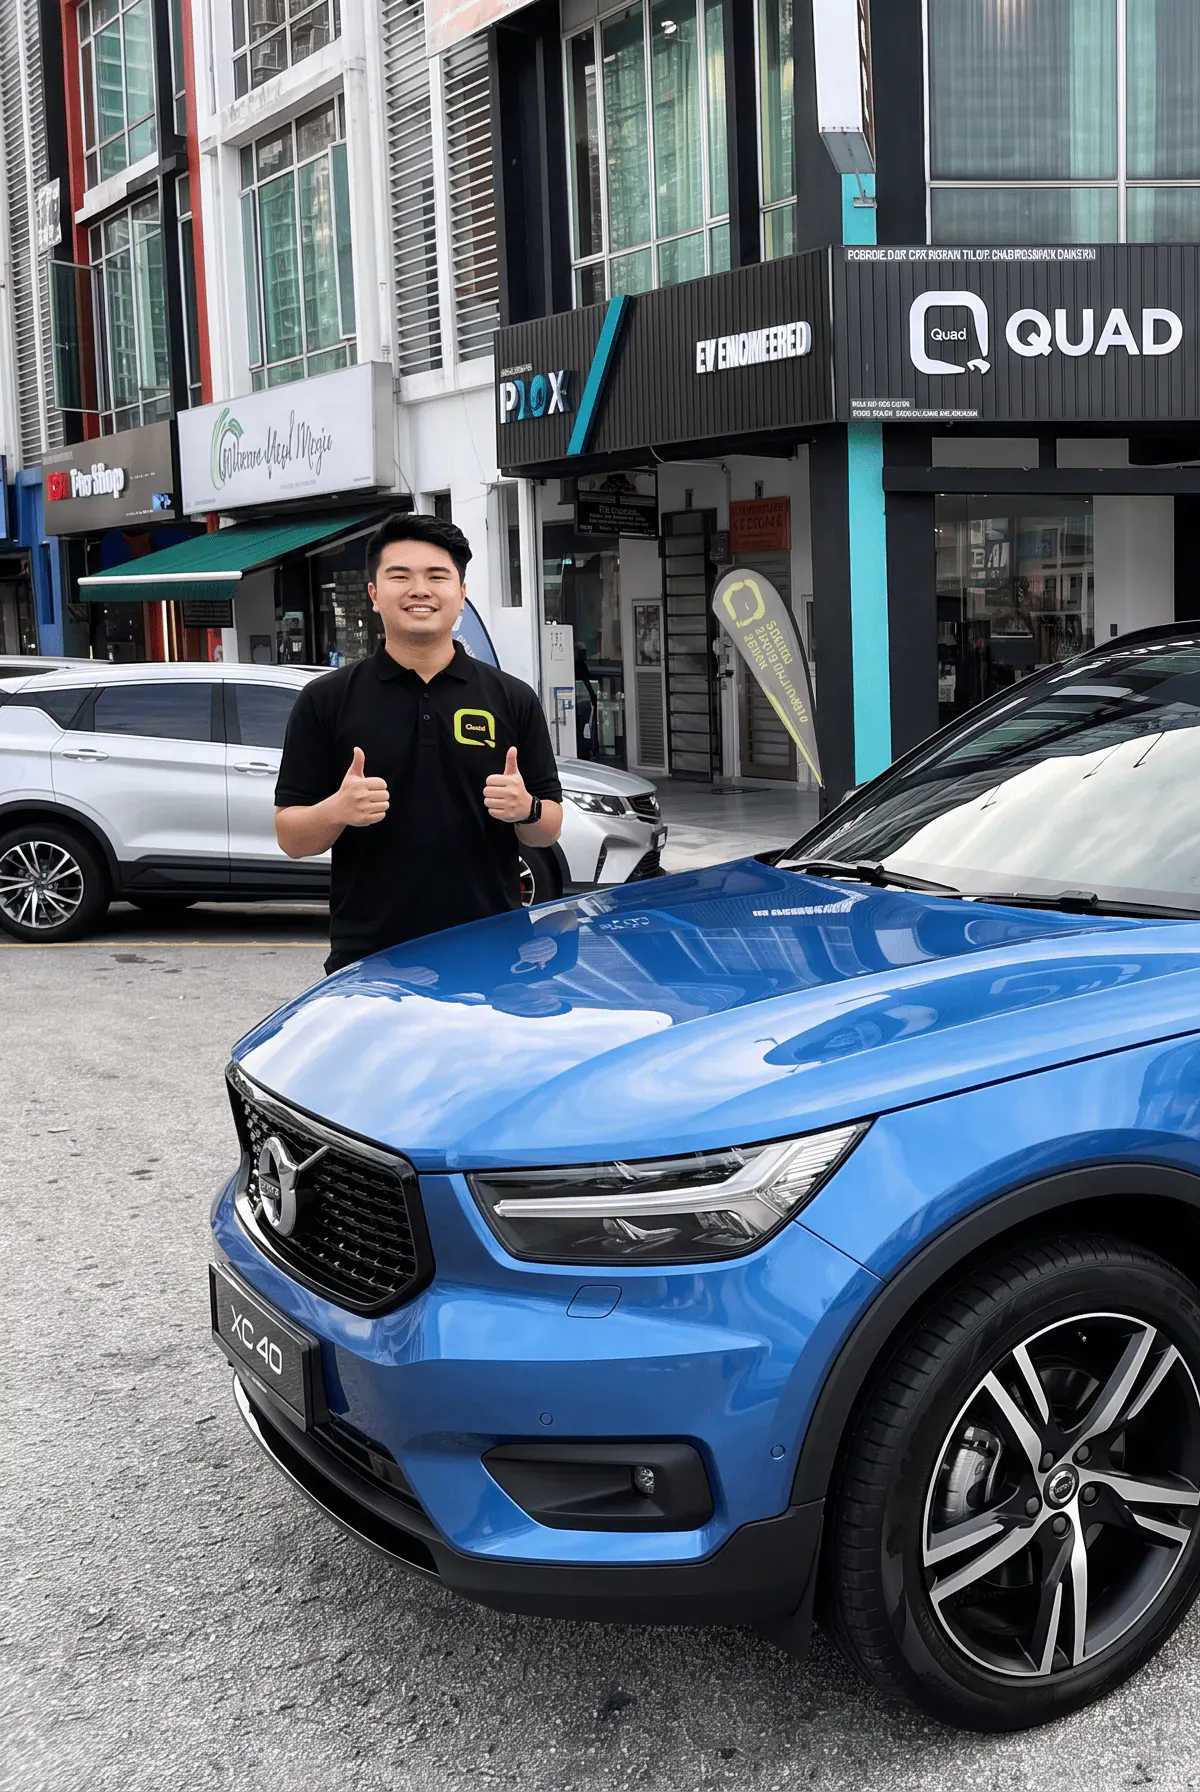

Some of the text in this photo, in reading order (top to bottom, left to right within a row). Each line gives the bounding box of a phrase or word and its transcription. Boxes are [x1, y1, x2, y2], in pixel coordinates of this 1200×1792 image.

[930, 327, 968, 342] Quad
[1004, 307, 1184, 358] QUAD
[696, 338, 717, 374] EV
[256, 1335, 283, 1375] 40
